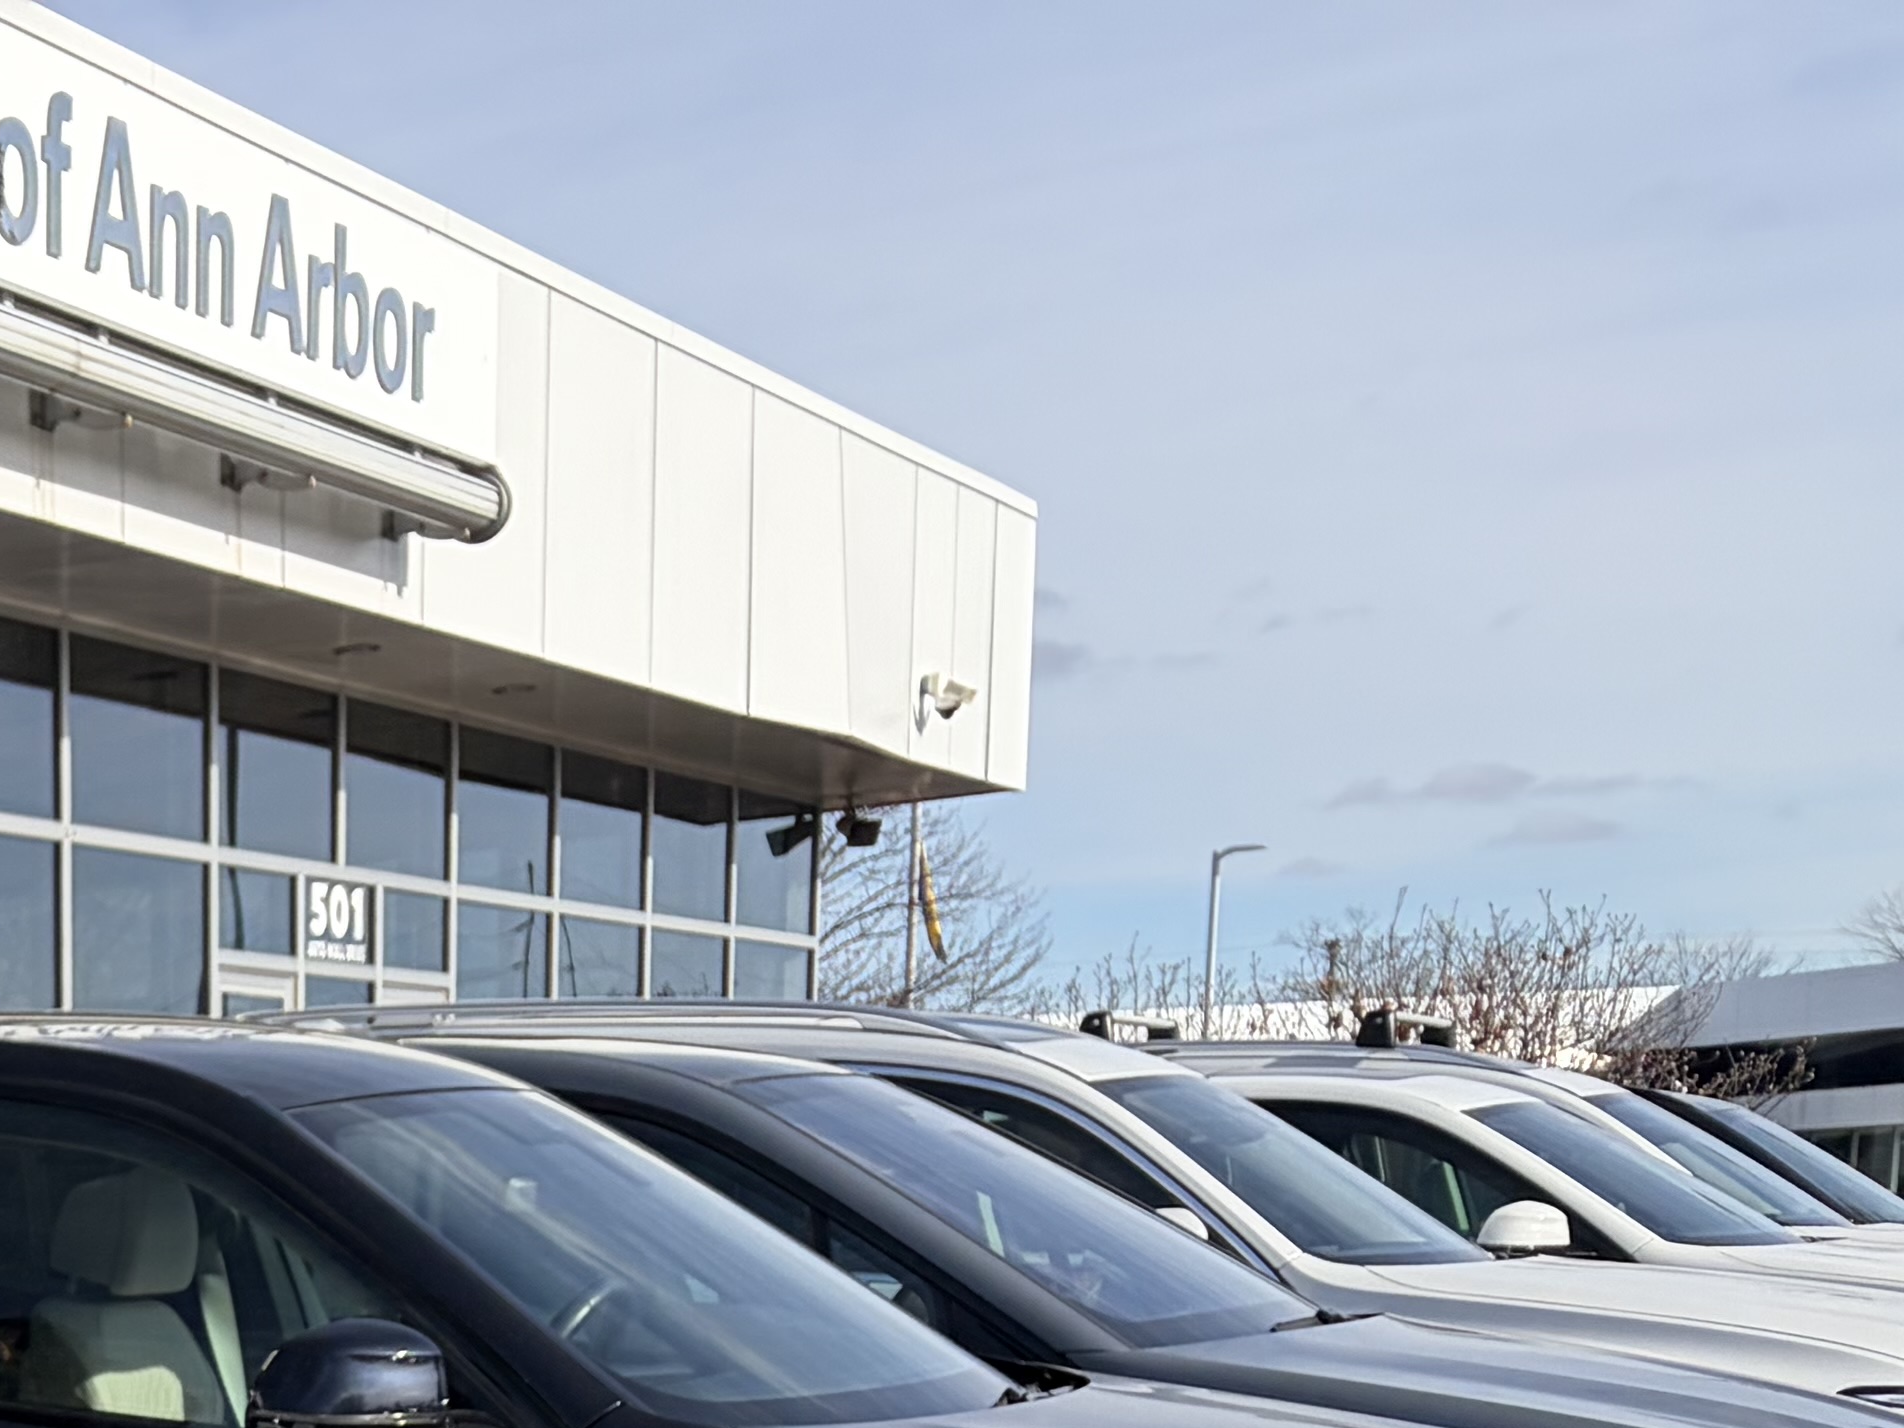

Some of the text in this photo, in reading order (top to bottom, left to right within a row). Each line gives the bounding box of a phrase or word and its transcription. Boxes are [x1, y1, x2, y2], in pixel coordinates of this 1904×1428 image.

[85, 116, 235, 328] Ann
[250, 193, 436, 403] Arbor
[309, 881, 365, 941] 501
